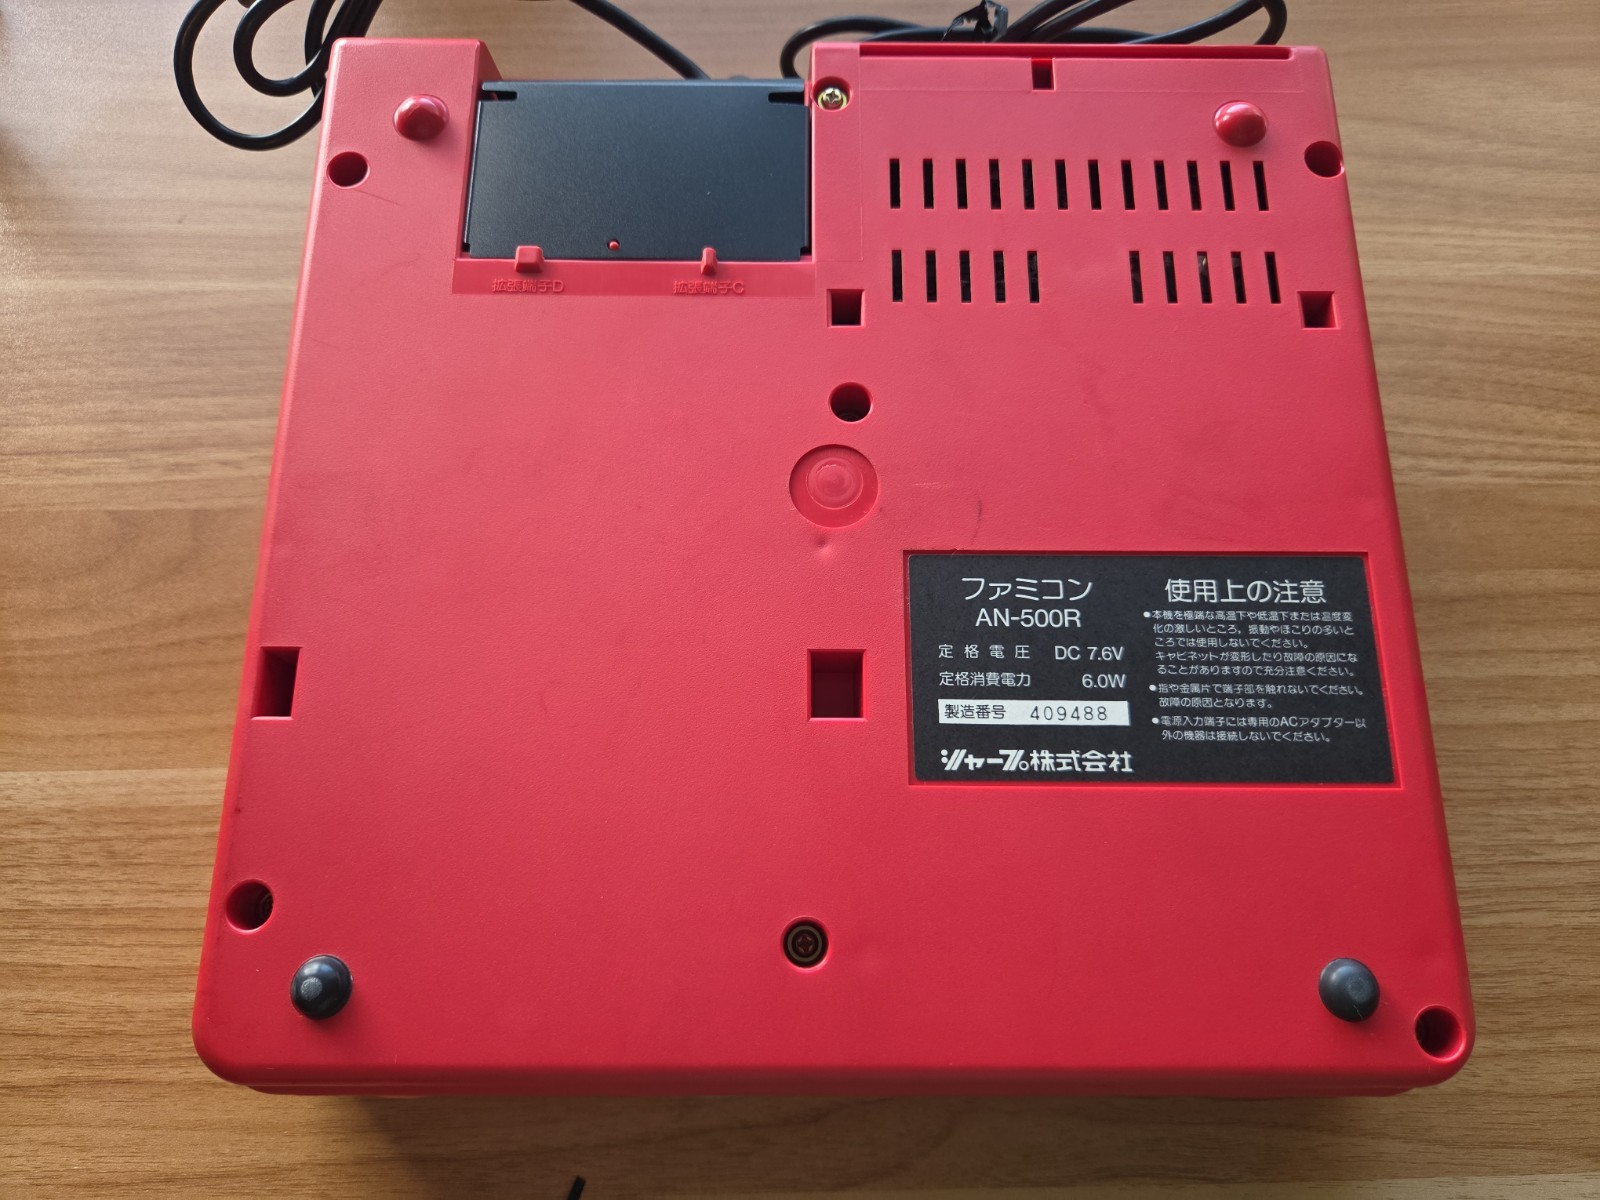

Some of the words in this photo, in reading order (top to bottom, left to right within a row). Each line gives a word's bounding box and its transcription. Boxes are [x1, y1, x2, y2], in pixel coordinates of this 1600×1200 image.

[492, 279, 565, 293] 拡張端子D
[673, 280, 745, 295] 拡張端子C
[962, 578, 1093, 601] ファミコン
[1165, 578, 1327, 604] 使用上の注意
[975, 608, 1082, 628] AN-500R
[1154, 637, 1309, 649] ころでは使用しないでください。
[1054, 646, 1081, 661] DC
[1087, 646, 1124, 661] 7.6V
[1155, 651, 1358, 663] キャビネットが変形したり故障の原因にな
[1157, 665, 1355, 677] ることがありますので充分注意ください。
[939, 671, 1032, 687] 定格消費電力
[1082, 673, 1126, 688] 6.0W
[1158, 683, 1364, 696] 指や金属片で端子部を触れないでください。
[1159, 697, 1273, 709] 故障の原因となります。
[944, 704, 1006, 720] 製造番号
[1030, 705, 1108, 721] 409488
[1162, 730, 1331, 743] 外の機器は接続しないでください。
